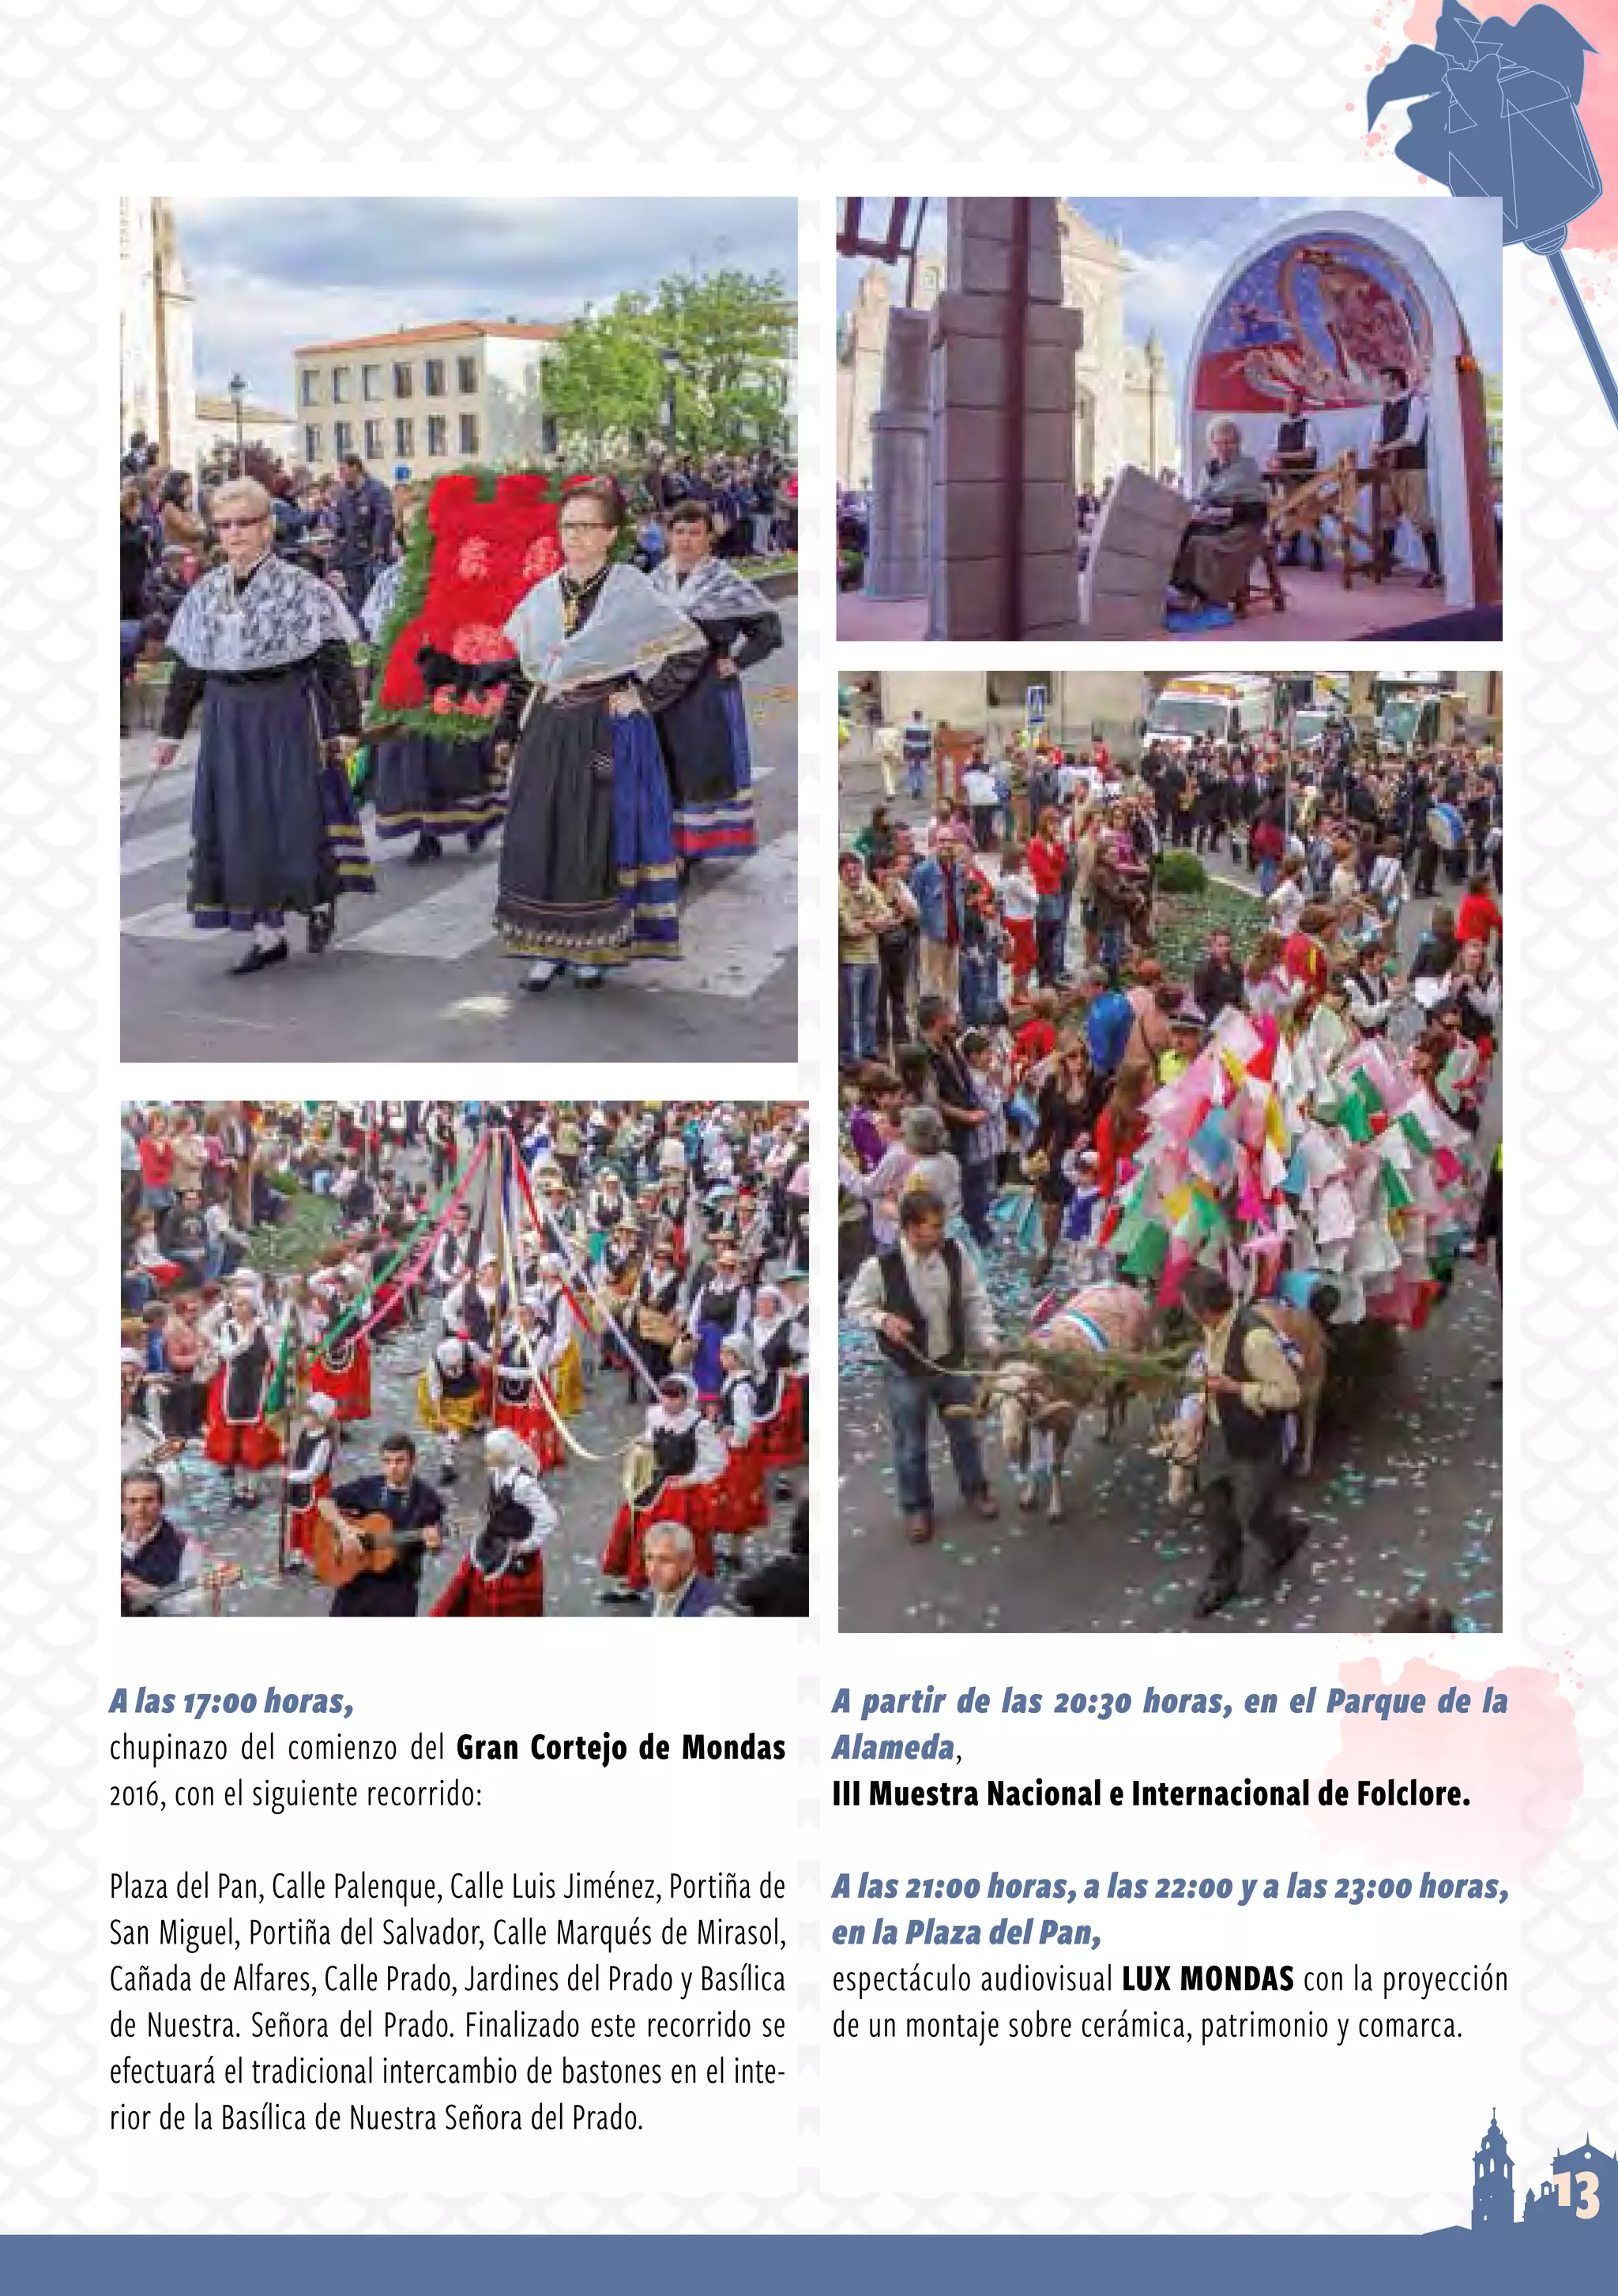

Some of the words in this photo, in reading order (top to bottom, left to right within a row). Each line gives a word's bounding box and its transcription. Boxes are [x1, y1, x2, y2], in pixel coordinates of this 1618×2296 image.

[108, 1688, 126, 1713] A
[135, 1687, 175, 1713] las
[184, 1693, 257, 1719] 17:00
[264, 1687, 352, 1718] horas,
[831, 1688, 849, 1712] A
[861, 1685, 946, 1720] partir
[958, 1687, 990, 1713] de
[1002, 1687, 1043, 1713] las
[1054, 1693, 1131, 1720] 20:30
[1143, 1687, 1232, 1718] horas,
[1245, 1694, 1277, 1713] en
[1290, 1687, 1316, 1713] el
[1326, 1688, 1425, 1720] Parque
[1438, 1687, 1470, 1713] de
[1483, 1687, 1507, 1713] la
[111, 1733, 227, 1767] chupinazo
[242, 1733, 273, 1760] del
[289, 1733, 396, 1760] comienzo
[412, 1733, 442, 1760] del
[457, 1734, 517, 1760] Gran
[532, 1732, 627, 1767] Cortejo
[639, 1733, 669, 1760] de
[683, 1733, 785, 1760] Mondas
[831, 1733, 961, 1765] Alameda,
[111, 1781, 165, 1811] 2016,
[175, 1787, 213, 1805] con
[225, 1778, 242, 1805] el
[253, 1780, 356, 1814] siguiente
[368, 1778, 480, 1805] recorrido:
[833, 1781, 860, 1805] III
[870, 1781, 978, 1806] Muestra
[988, 1778, 1101, 1806] Nacional
[1110, 1786, 1123, 1805] e
[1133, 1778, 1308, 1806] Internacional
[1319, 1778, 1349, 1806] de
[1358, 1779, 1469, 1806] Folclore.
[111, 1871, 167, 1899] Plaza
[177, 1871, 208, 1899] del
[220, 1873, 264, 1903] Pan,
[273, 1871, 325, 1899] Calle
[336, 1871, 442, 1906] Palenque,
[451, 1871, 503, 1899] Calle
[514, 1873, 555, 1899] Luis
[564, 1871, 661, 1903] Jiménez,
[671, 1873, 751, 1899] Portiña
[760, 1871, 785, 1899] de
[831, 1873, 849, 1898] A
[858, 1872, 898, 1898] las
[906, 1879, 980, 1898] 21:00
[988, 1872, 1076, 1903] horas,
[1084, 1879, 1099, 1898] a
[1108, 1872, 1148, 1898] las
[1155, 1879, 1232, 1898] 22:00
[1238, 1880, 1258, 1906] y
[1263, 1879, 1278, 1898] a
[1287, 1872, 1327, 1898] las
[1334, 1879, 1412, 1905] 23:00
[1420, 1872, 1507, 1903] horas,
[111, 1919, 148, 1944] San
[160, 1918, 239, 1953] Miguel,
[251, 1918, 330, 1944] Portiña
[341, 1918, 371, 1944] del
[383, 1918, 484, 1950] Salvador,
[495, 1918, 546, 1944] Calle
[558, 1917, 651, 1953] Marqués
[662, 1918, 687, 1944] de
[698, 1918, 785, 1950] Mirasol,
[833, 1925, 865, 1944] en
[872, 1918, 897, 1944] la
[905, 1918, 980, 1944] Plaza
[989, 1918, 1033, 1944] del
[1039, 1920, 1101, 1950] Pan,
[111, 1964, 191, 1991] Cañada
[201, 1963, 225, 1991] de
[234, 1963, 316, 1996] Alfares,
[325, 1963, 377, 1991] Calle
[388, 1963, 457, 1996] Prado,
[465, 1964, 558, 1991] Jardines
[568, 1964, 598, 1991] del
[610, 1963, 672, 1991] Prado
[680, 1972, 692, 2000] y
[702, 1963, 785, 1991] Basílica
[833, 1963, 970, 1999] espectáculo
[982, 1963, 1111, 1991] audiovisual
[1123, 1966, 1171, 1991] LUX
[1181, 1966, 1293, 1991] MONDAS
[1304, 1972, 1342, 1991] con
[1355, 1964, 1372, 1991] la
[1384, 1963, 1507, 2000] proyección
[111, 2010, 135, 2037] de
[149, 2012, 239, 2037] Nuestra.
[252, 2012, 328, 2037] Señora
[341, 2010, 371, 2037] del
[386, 2010, 453, 2037] Prado.
[467, 2010, 578, 2037] Finalizado
[592, 2015, 635, 2037] este
[649, 2010, 751, 2037] recorrido
[763, 2019, 785, 2037] se
[833, 2010, 858, 2037] de
[870, 2019, 895, 2037] un
[907, 2011, 999, 2046] montaje
[1010, 2010, 1071, 2037] sobre
[1082, 2009, 1191, 2042] cerámica,
[1202, 2011, 1327, 2046] patrimonio
[1338, 2019, 1349, 2046] y
[1359, 2018, 1462, 2037] comarca.
[111, 2056, 215, 2083] efectuará
[225, 2057, 242, 2083] el
[252, 2057, 371, 2083] tradicional
[384, 2057, 516, 2083] intercambio
[527, 2057, 551, 2083] de
[563, 2057, 661, 2083] bastones
[672, 2065, 695, 2083] en
[707, 2057, 723, 2083] el
[736, 2057, 785, 2083] inte-
[111, 2104, 151, 2129] rior
[160, 2102, 184, 2129] de
[195, 2102, 212, 2129] la
[223, 2102, 306, 2129] Basílica
[316, 2102, 340, 2129] de
[352, 2105, 436, 2129] Nuestra
[446, 2104, 521, 2129] Señora
[532, 2102, 563, 2129] del
[574, 2102, 642, 2129] Prado.
[1552, 2171, 1600, 2219] 13
